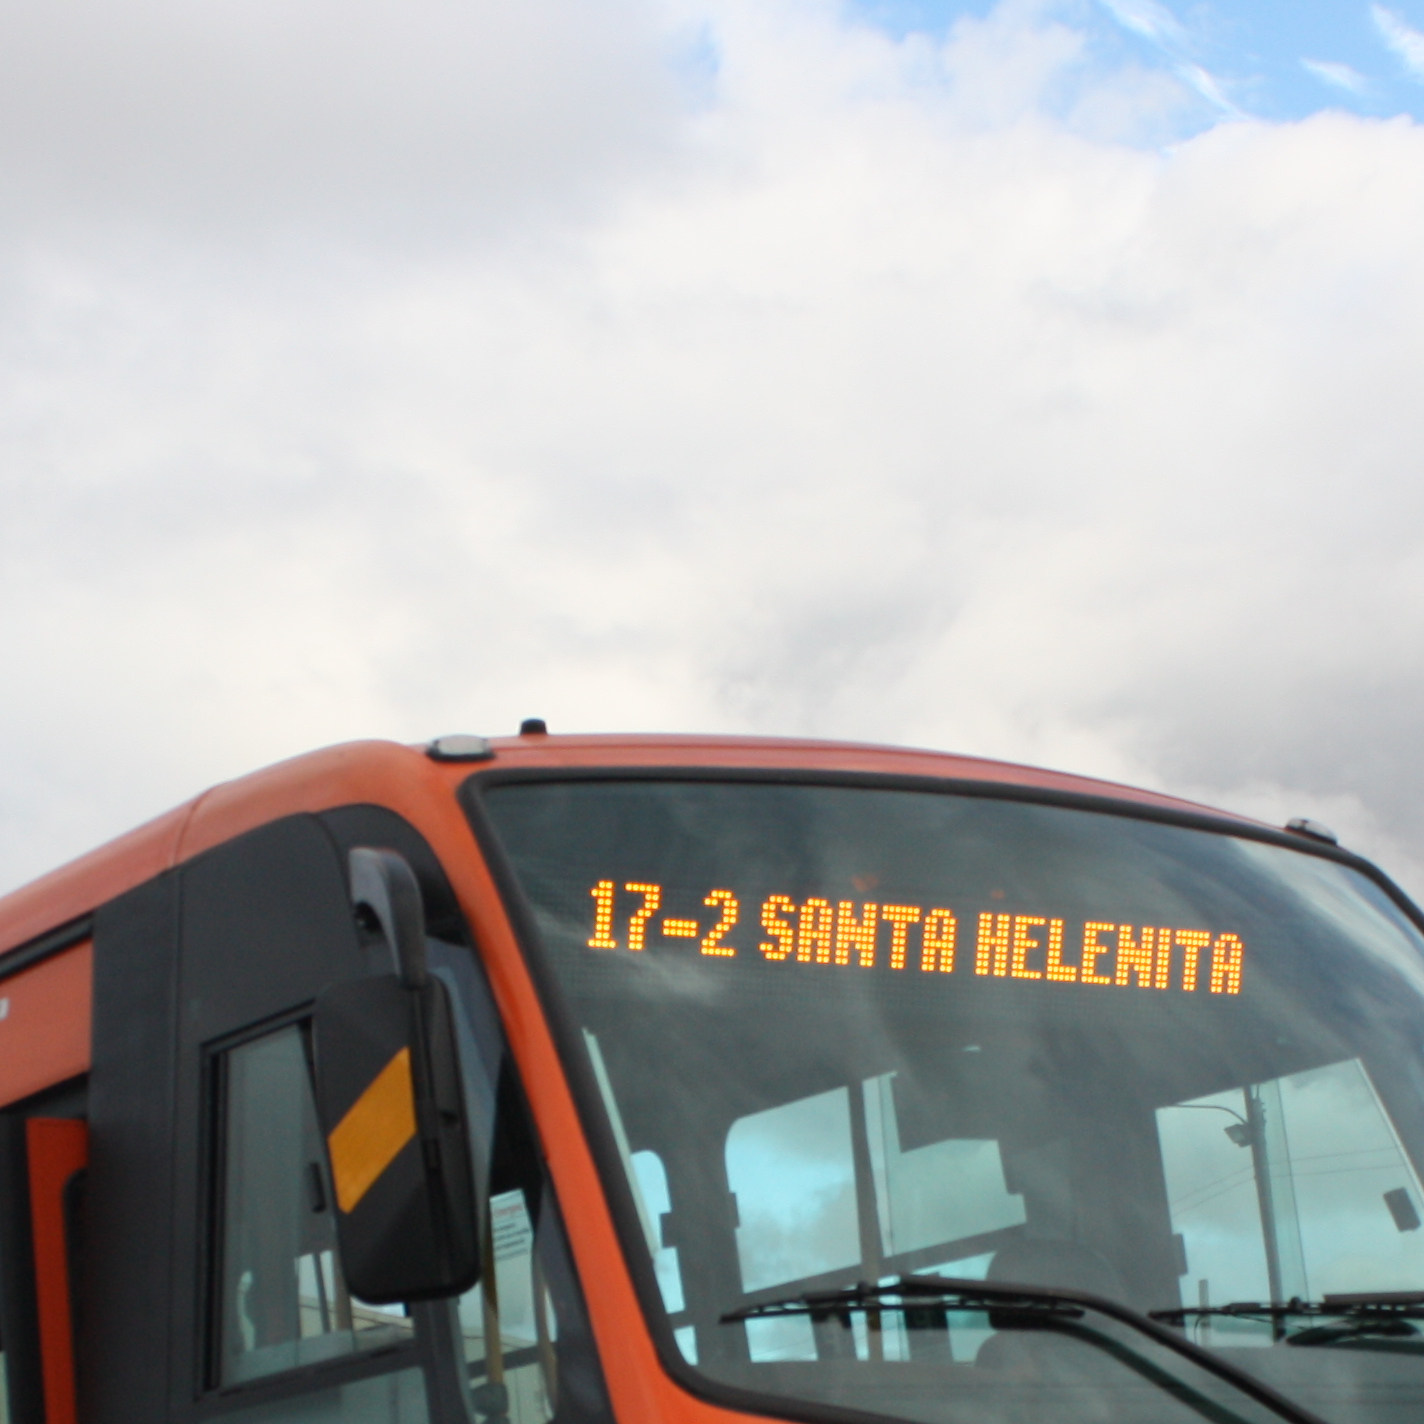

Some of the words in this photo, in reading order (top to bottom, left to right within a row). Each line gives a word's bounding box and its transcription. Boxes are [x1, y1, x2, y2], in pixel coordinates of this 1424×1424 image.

[588, 879, 739, 957] 17-2
[759, 894, 958, 974] SANTA
[974, 911, 1246, 995] HELENITA
